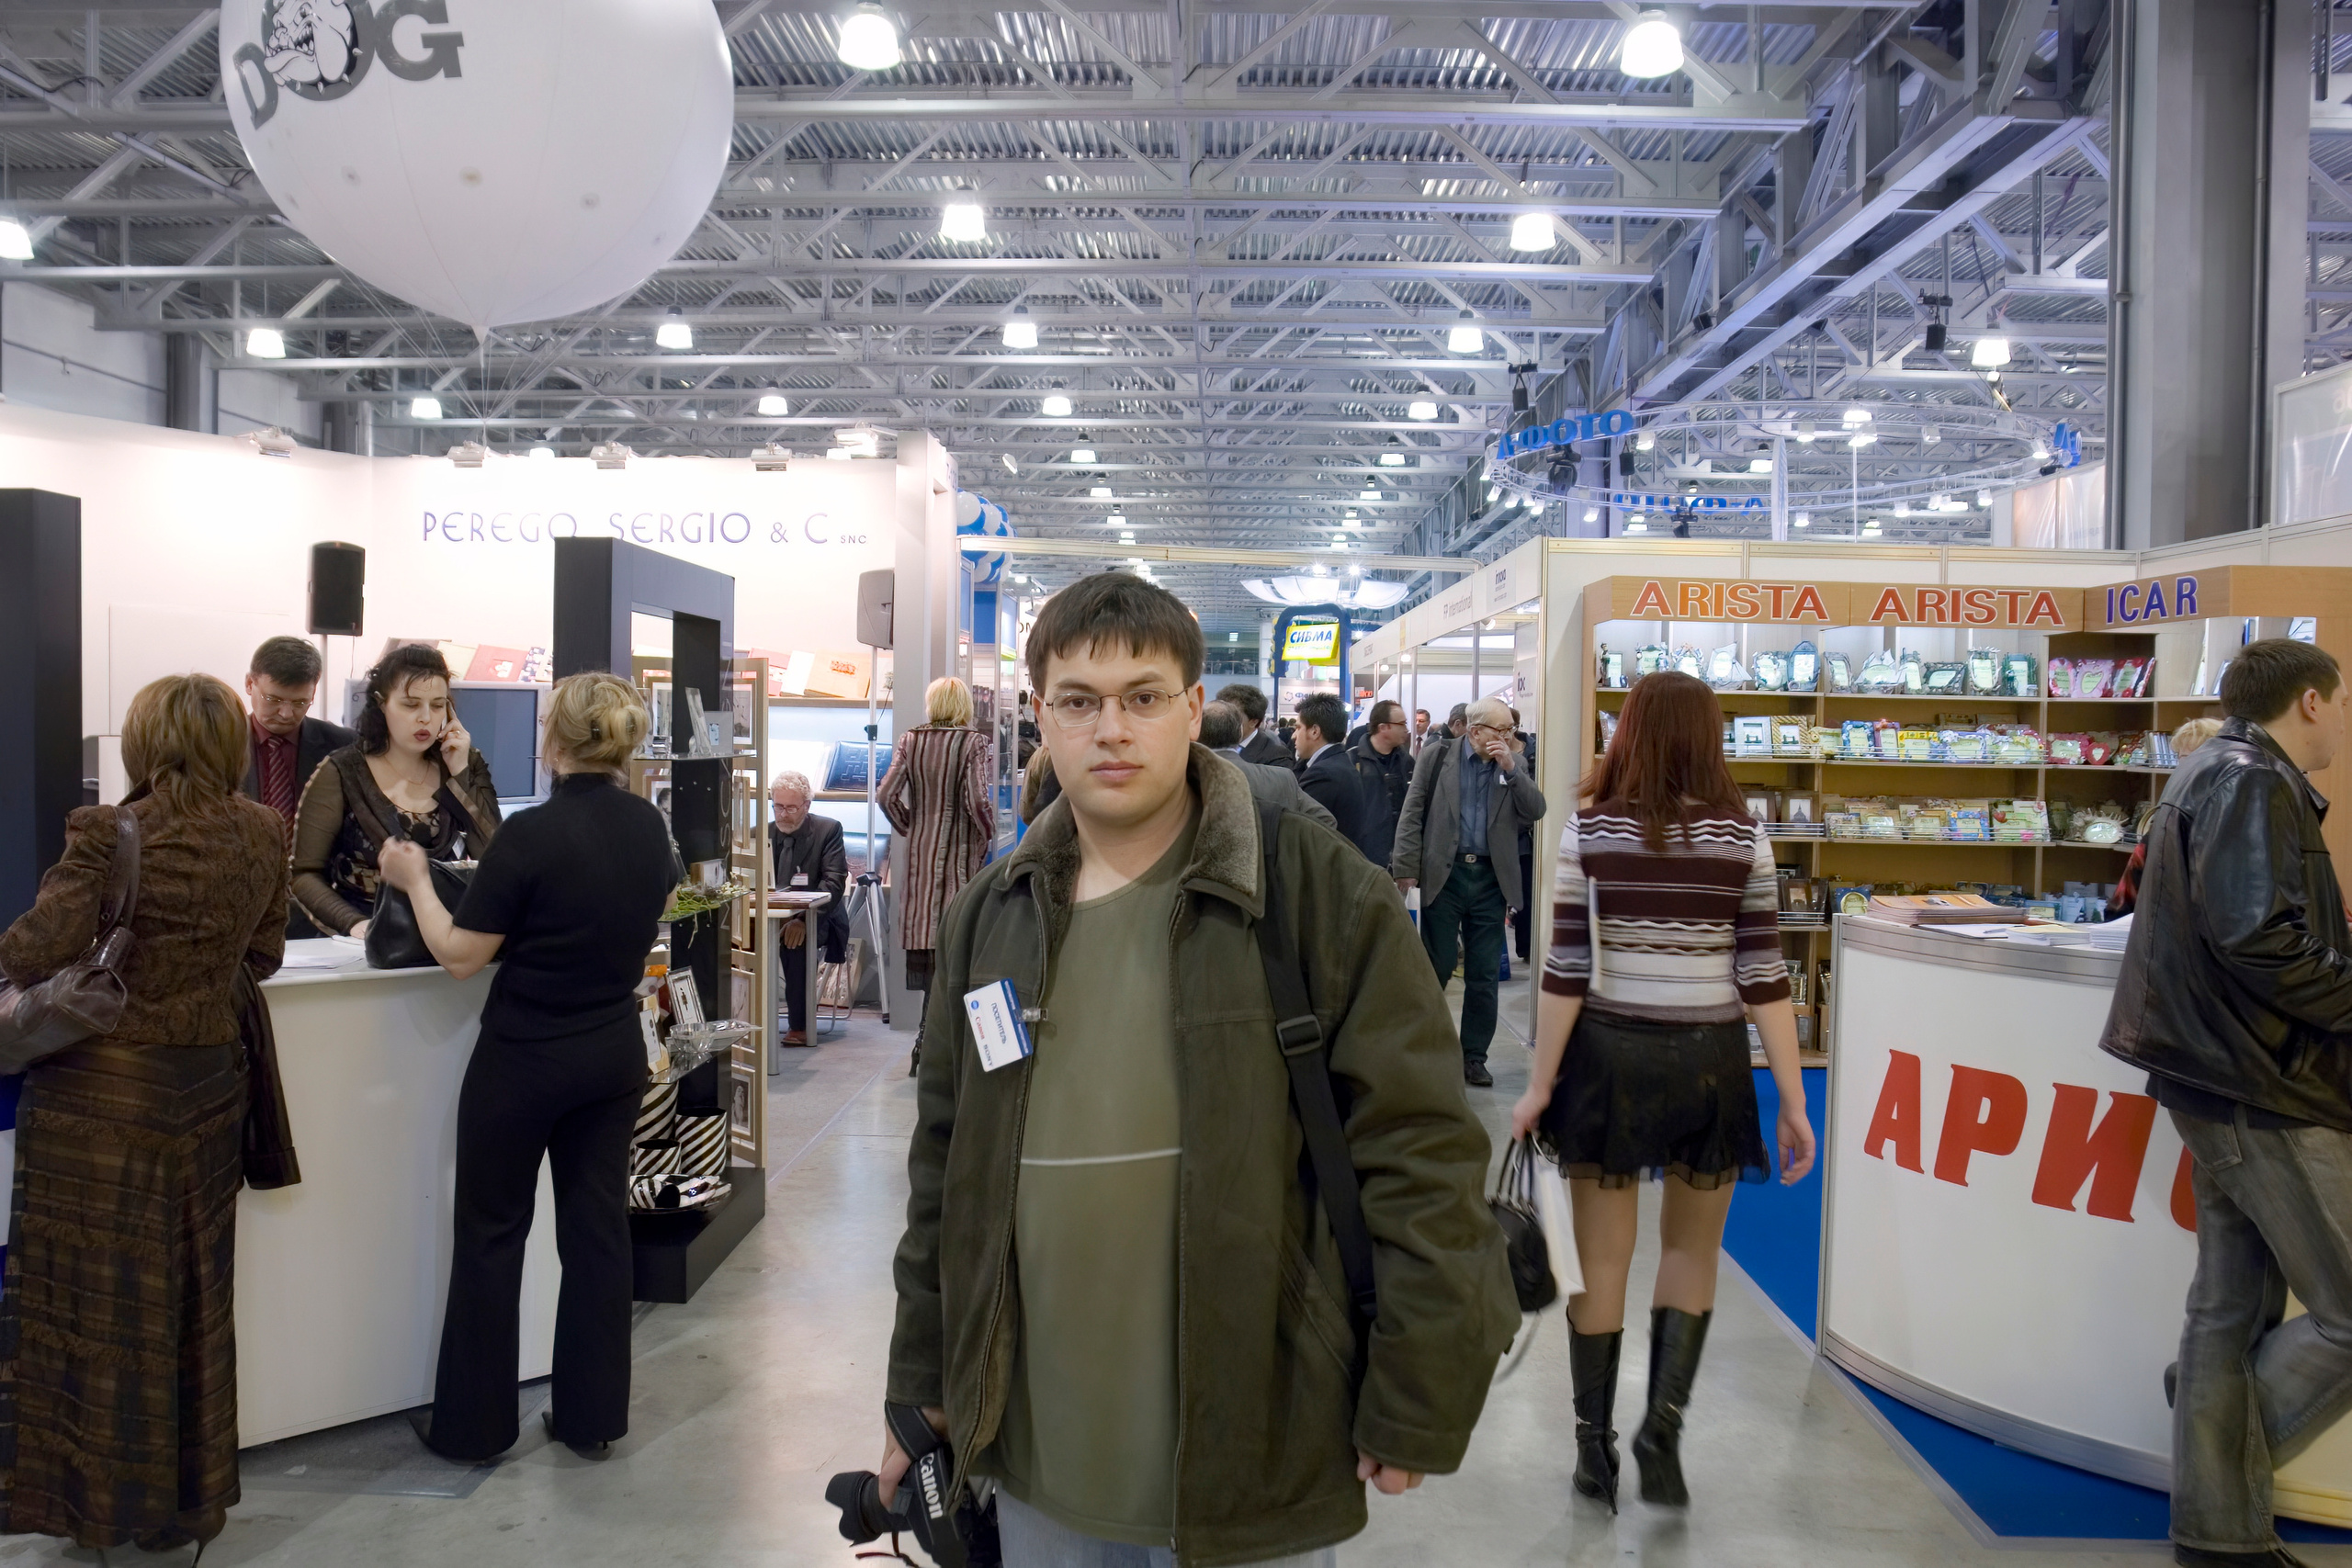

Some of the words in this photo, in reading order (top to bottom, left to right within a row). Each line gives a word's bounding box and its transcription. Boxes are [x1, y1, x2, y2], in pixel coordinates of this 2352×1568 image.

[232, 0, 465, 130] DOG
[422, 511, 578, 543] PEREGO
[609, 511, 752, 544] SERGIO
[769, 521, 789, 544] &
[804, 512, 829, 544] C
[840, 536, 867, 544] SNC
[1629, 579, 1830, 620] ARISTA
[1870, 586, 2066, 626] ARISTA
[2105, 576, 2199, 626] ICAR
[975, 1016, 986, 1040] Canon
[983, 1043, 993, 1066] SONY
[920, 1452, 944, 1520] Canon
